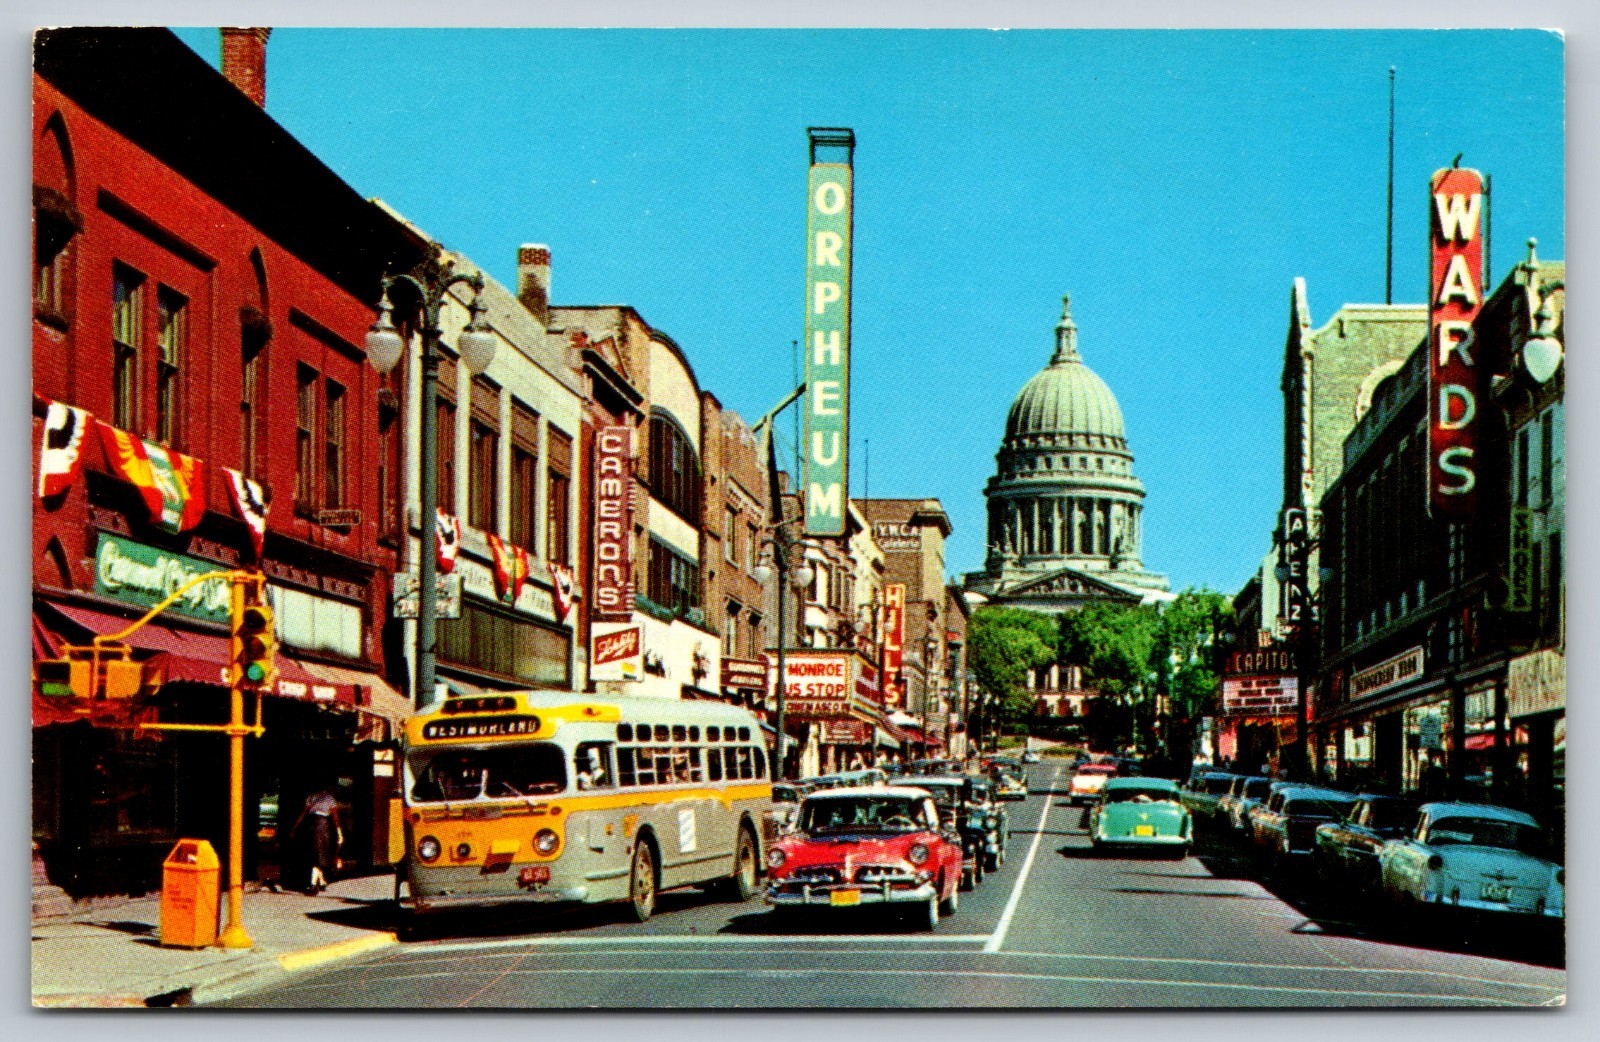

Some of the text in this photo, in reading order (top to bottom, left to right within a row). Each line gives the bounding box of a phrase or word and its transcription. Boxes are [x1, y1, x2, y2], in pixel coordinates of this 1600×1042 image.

[809, 181, 846, 519] ORPHEUM
[1435, 193, 1482, 496] WARDS
[598, 435, 624, 606] CAMERON'S
[877, 524, 921, 537] YMCA
[787, 663, 844, 677] MONROE
[884, 587, 902, 703] HILL'S
[1236, 651, 1298, 673] CAPITOL
[806, 683, 846, 698] STOP
